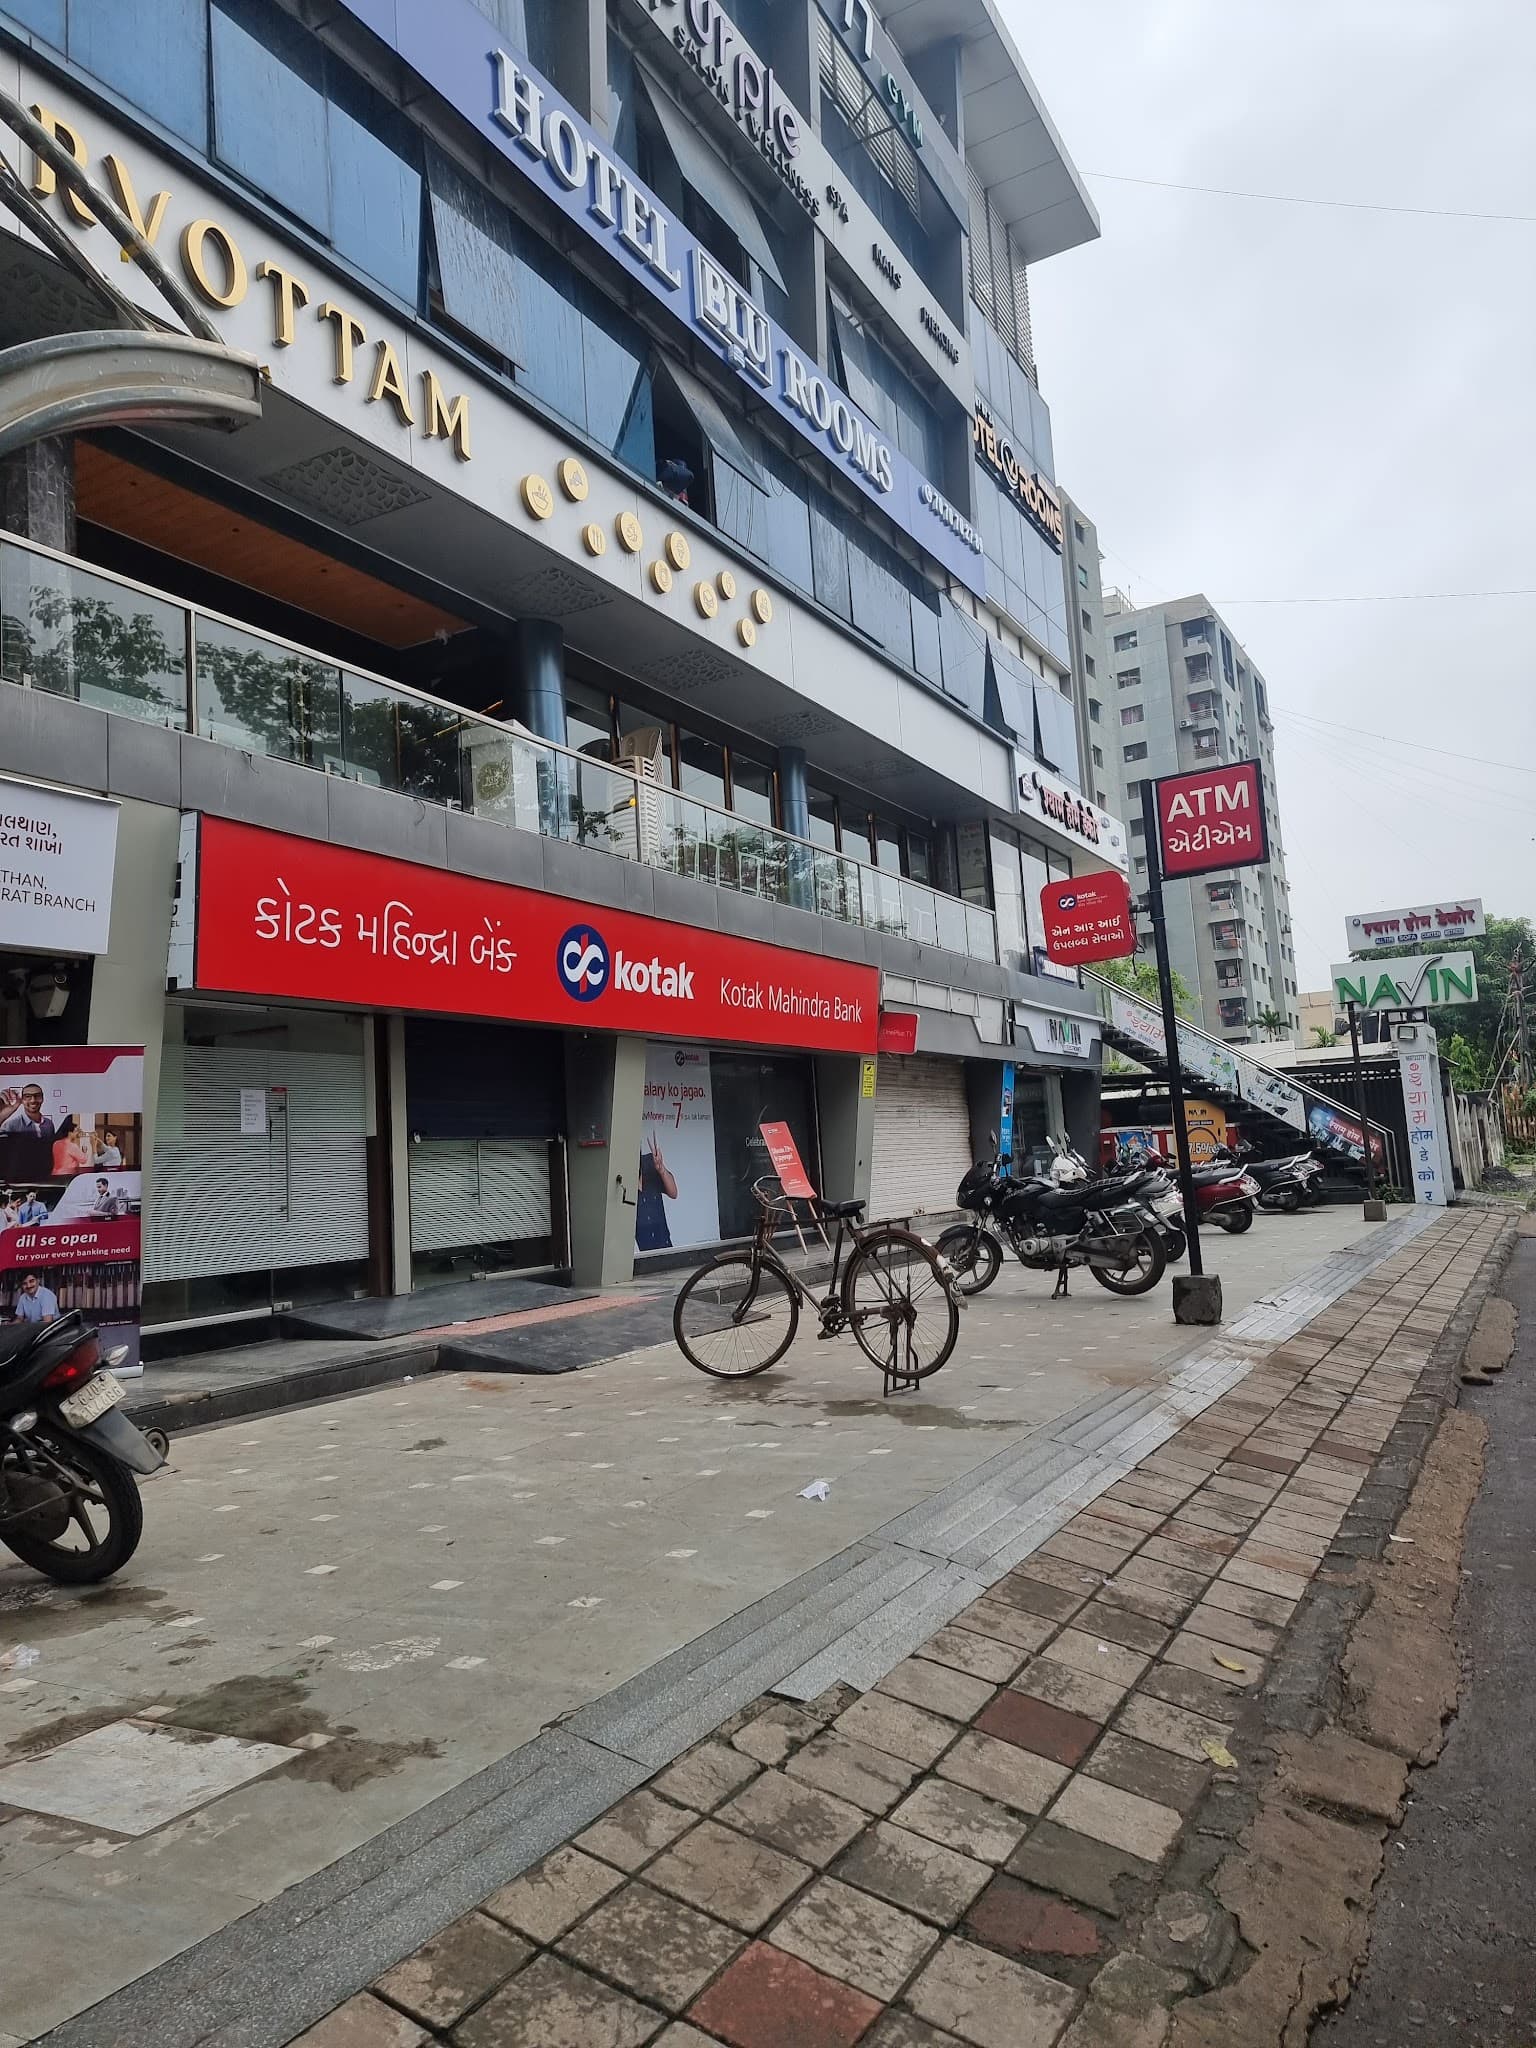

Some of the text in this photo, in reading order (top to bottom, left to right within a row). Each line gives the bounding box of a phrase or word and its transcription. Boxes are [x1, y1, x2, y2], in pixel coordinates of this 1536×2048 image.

[649, 0, 800, 158] urple
[674, 25, 820, 218] SALON WELLNESS
[882, 72, 923, 149] GYM
[826, 185, 850, 223] SPA
[491, 48, 894, 494] HOTEL BLU ROOMS
[871, 243, 902, 290] NAILS
[0, 103, 472, 463] RVOTTAM
[919, 306, 960, 365] PIERCING
[1018, 465, 1064, 543] ROOMS
[1167, 781, 1250, 822] ATM
[0, 813, 57, 839] લથાણ,
[1168, 821, 1252, 853] એટીએમ
[25, 836, 62, 855] શાખા
[0, 868, 47, 890] THAN,
[33, 893, 96, 912] BRANCH
[1077, 891, 1097, 900] kotak
[254, 877, 518, 973] કોટક મહિન્દ્રા બેંક
[1051, 915, 1121, 937] એન આર આઈ
[1053, 929, 1124, 951] ઉપલબ્ધ સેવાઓ
[614, 950, 863, 1024] kotak Kotak Mahindra Bank
[1334, 956, 1473, 1010] NAVIN
[882, 1028, 905, 1037] OnePlus
[24, 1055, 52, 1063] BANK
[668, 1083, 679, 1098] ko
[681, 1083, 706, 1101] jagao.
[1410, 1127, 1433, 1145] होम
[15, 1245, 131, 1261] for your every banking need
[16, 1233, 98, 1248] dil se open
